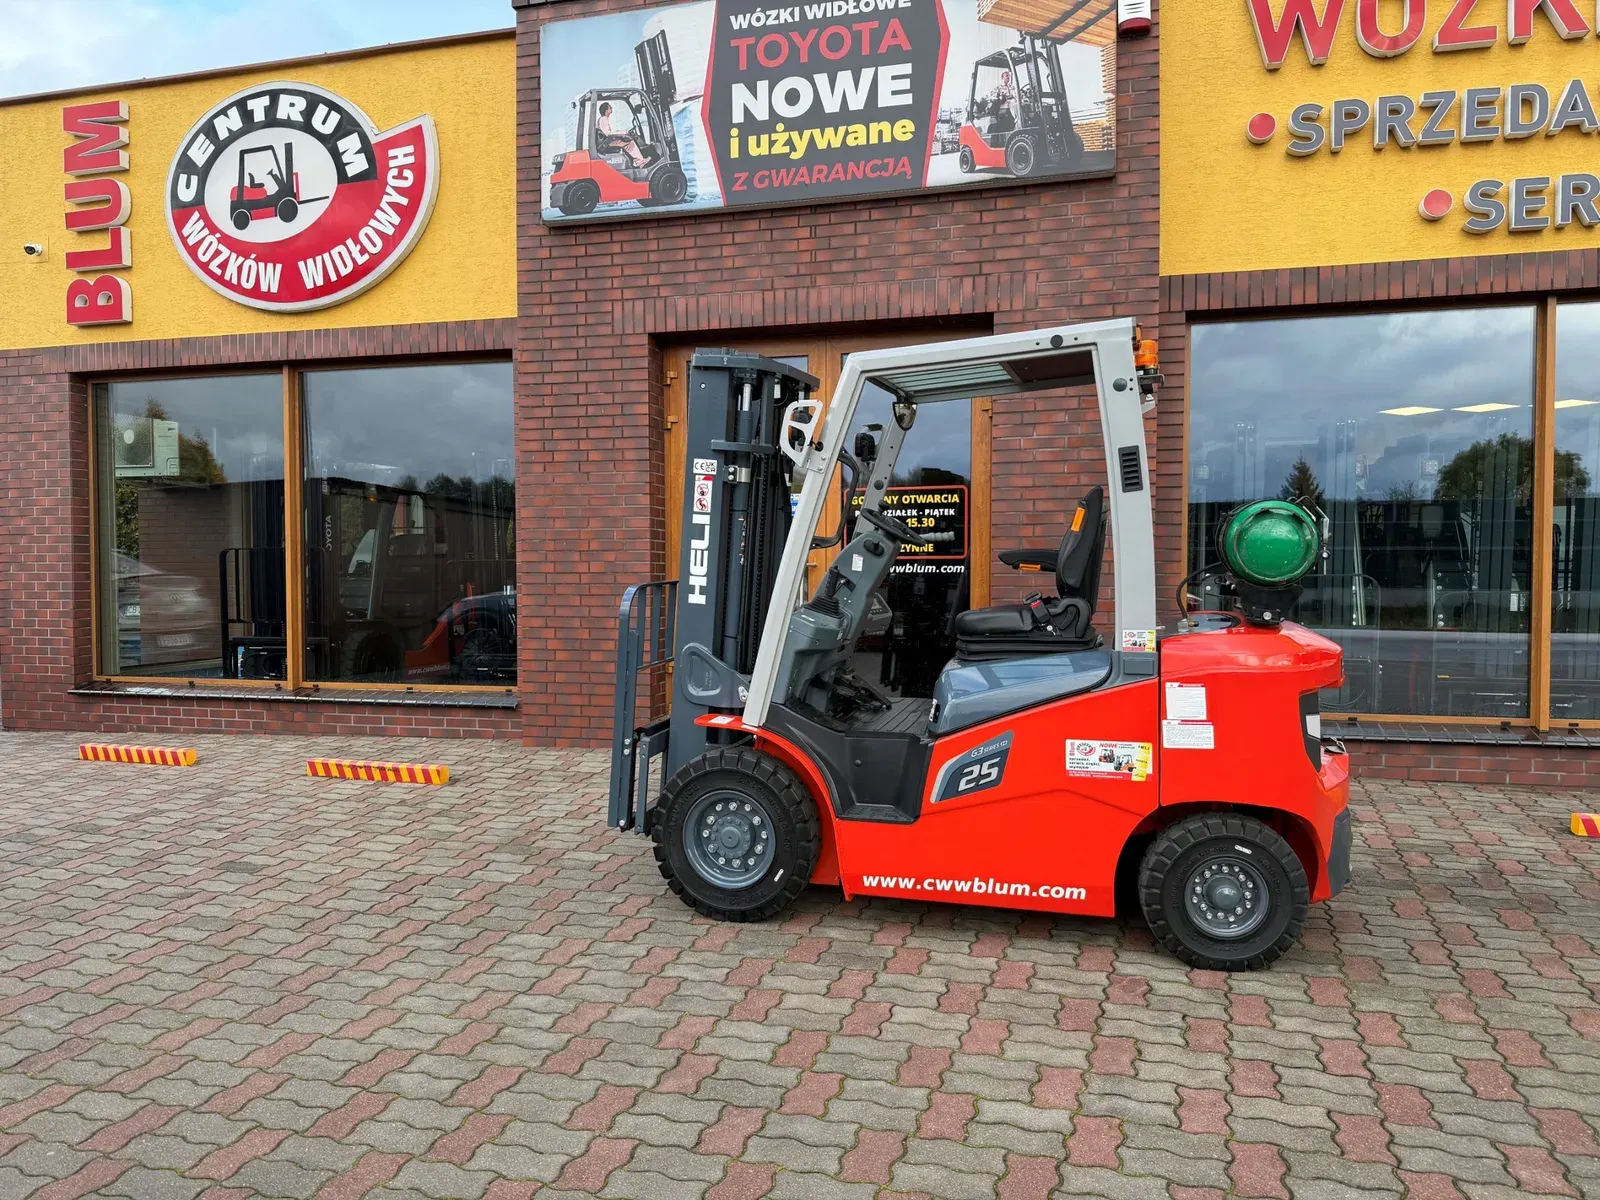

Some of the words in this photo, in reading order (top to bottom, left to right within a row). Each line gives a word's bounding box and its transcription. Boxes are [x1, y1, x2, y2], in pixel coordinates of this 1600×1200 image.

[729, 6, 800, 31] WÓZKI
[730, 17, 912, 71] TOYOTA
[731, 62, 913, 124] NOWE
[1286, 79, 1600, 156] SPRZEDA
[177, 93, 370, 203] CENTRUM
[729, 127, 740, 159] i
[748, 118, 915, 160] używane
[732, 171, 749, 192] Z
[753, 156, 912, 190] GWARANCJĄ
[62, 99, 131, 327] BLUM
[181, 209, 283, 295] WÓZKÓW
[297, 143, 416, 291] WIDŁOWYCH
[902, 494, 960, 504] OTWARCIA
[924, 508, 955, 517] PIĄTEK
[688, 513, 711, 605] HELI
[971, 746, 984, 758] G3
[958, 756, 1001, 792] 25
[862, 874, 1087, 901] www.cwwblum.com
